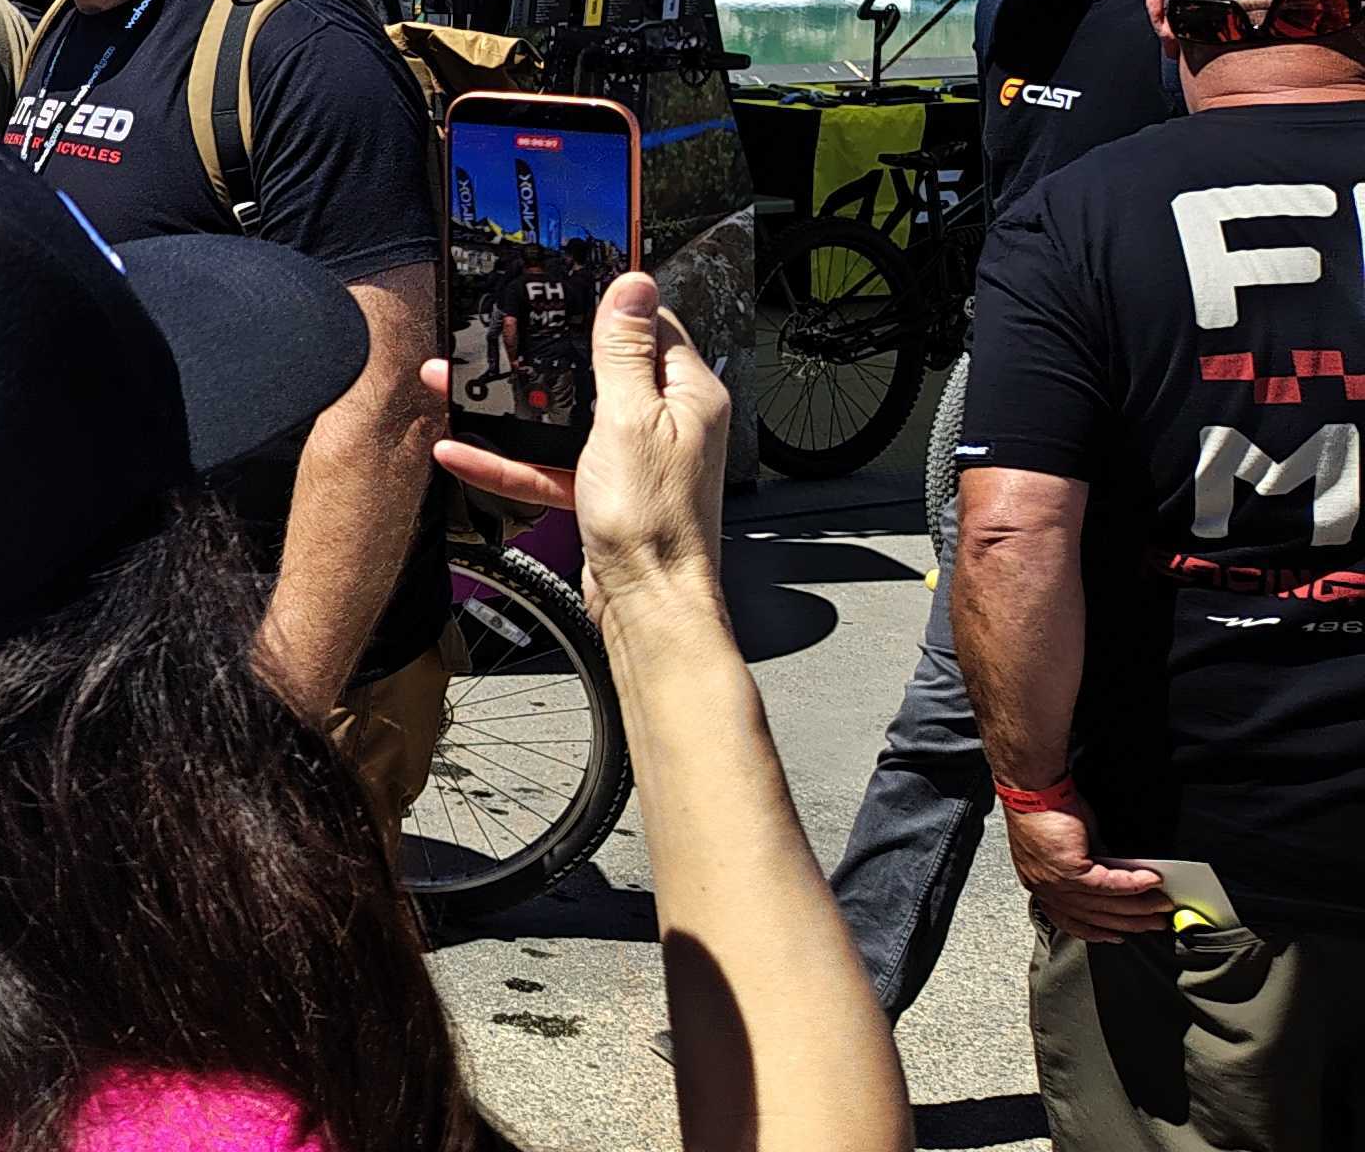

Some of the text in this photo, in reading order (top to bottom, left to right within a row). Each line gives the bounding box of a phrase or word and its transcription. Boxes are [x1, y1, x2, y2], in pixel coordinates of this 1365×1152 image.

[1022, 84, 1082, 110] CAST
[56, 141, 122, 165] ICYCLES
[1171, 184, 1365, 329] F
[525, 282, 565, 301] FH
